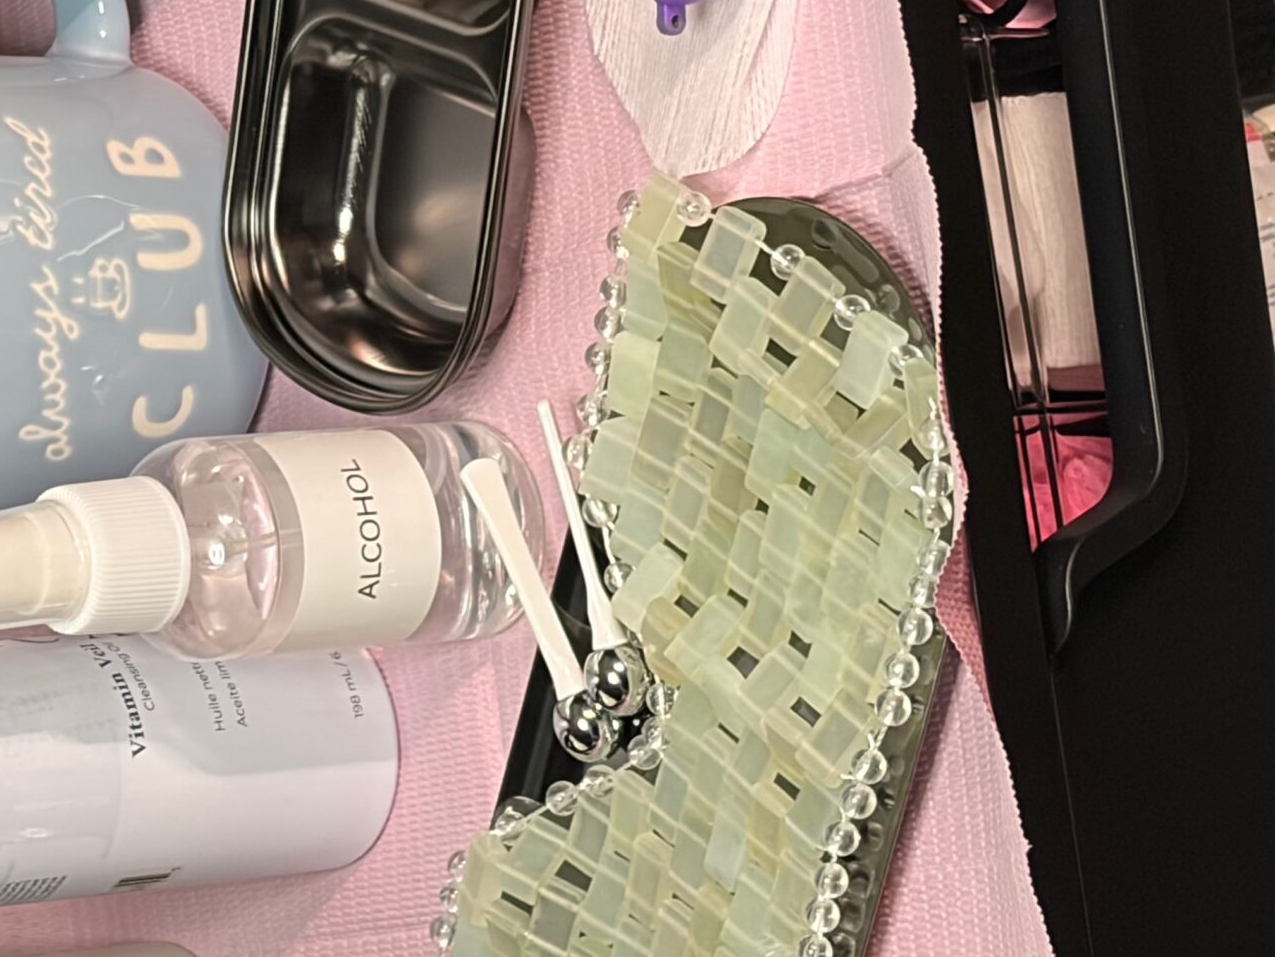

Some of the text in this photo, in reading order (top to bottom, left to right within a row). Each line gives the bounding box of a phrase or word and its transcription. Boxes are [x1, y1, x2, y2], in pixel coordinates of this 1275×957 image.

[2, 114, 79, 461] always tired
[106, 136, 207, 438] CLUB
[340, 459, 382, 599] ALCOHOL
[111, 672, 147, 758] Vitamin
[116, 653, 156, 712] Cleansing
[225, 682, 248, 728] Aceite
[340, 668, 357, 692] mL
[349, 694, 365, 719] 198
